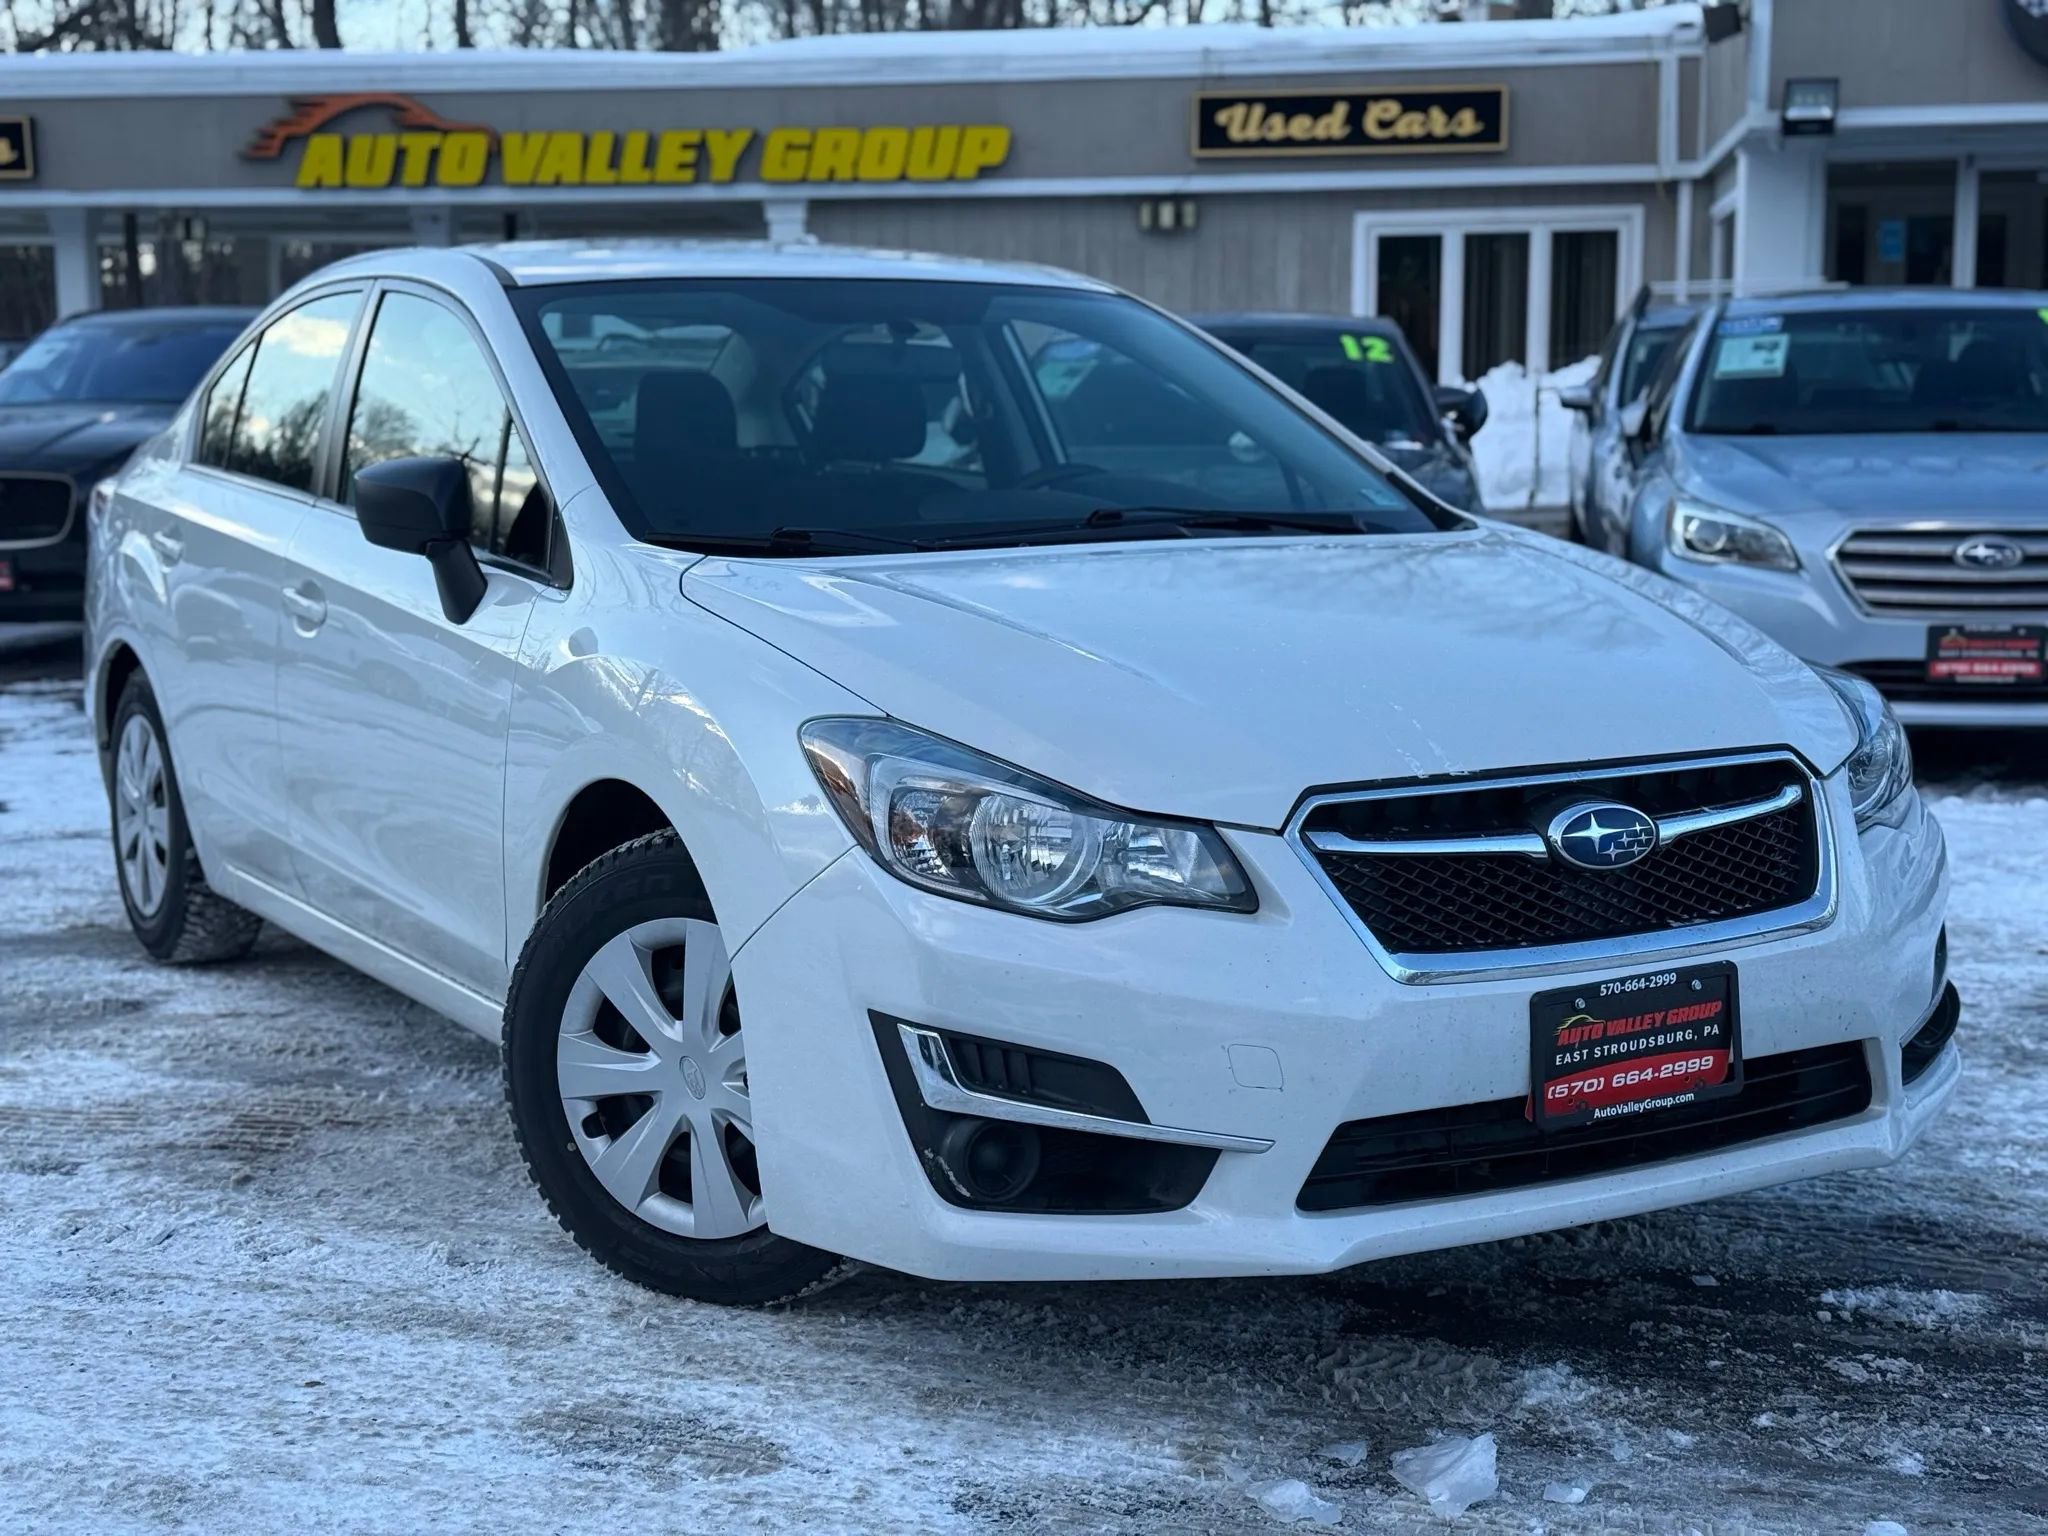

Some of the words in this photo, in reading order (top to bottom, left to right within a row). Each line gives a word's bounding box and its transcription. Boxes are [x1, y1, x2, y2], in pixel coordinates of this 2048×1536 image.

[1214, 101, 1350, 142] Used
[1362, 99, 1485, 139] Cars
[295, 133, 489, 187] AUTO
[502, 130, 752, 185] VALLEY
[760, 125, 1012, 183] GROUP
[1340, 334, 1394, 364] 12
[1600, 972, 1677, 996] 570-664-2999
[1556, 1049, 1588, 1065] EAST
[1594, 1029, 1699, 1058] STROUDSBURG,
[1703, 1024, 1720, 1036] PA
[1557, 1021, 1605, 1046] AUTO
[1606, 1011, 1666, 1036] VALLEY
[1667, 1001, 1723, 1025] GROUP
[1547, 1079, 1605, 1099] (570)
[1612, 1055, 1714, 1085] 664-2999
[1594, 1092, 1695, 1119] AutoValleyGroup.com
